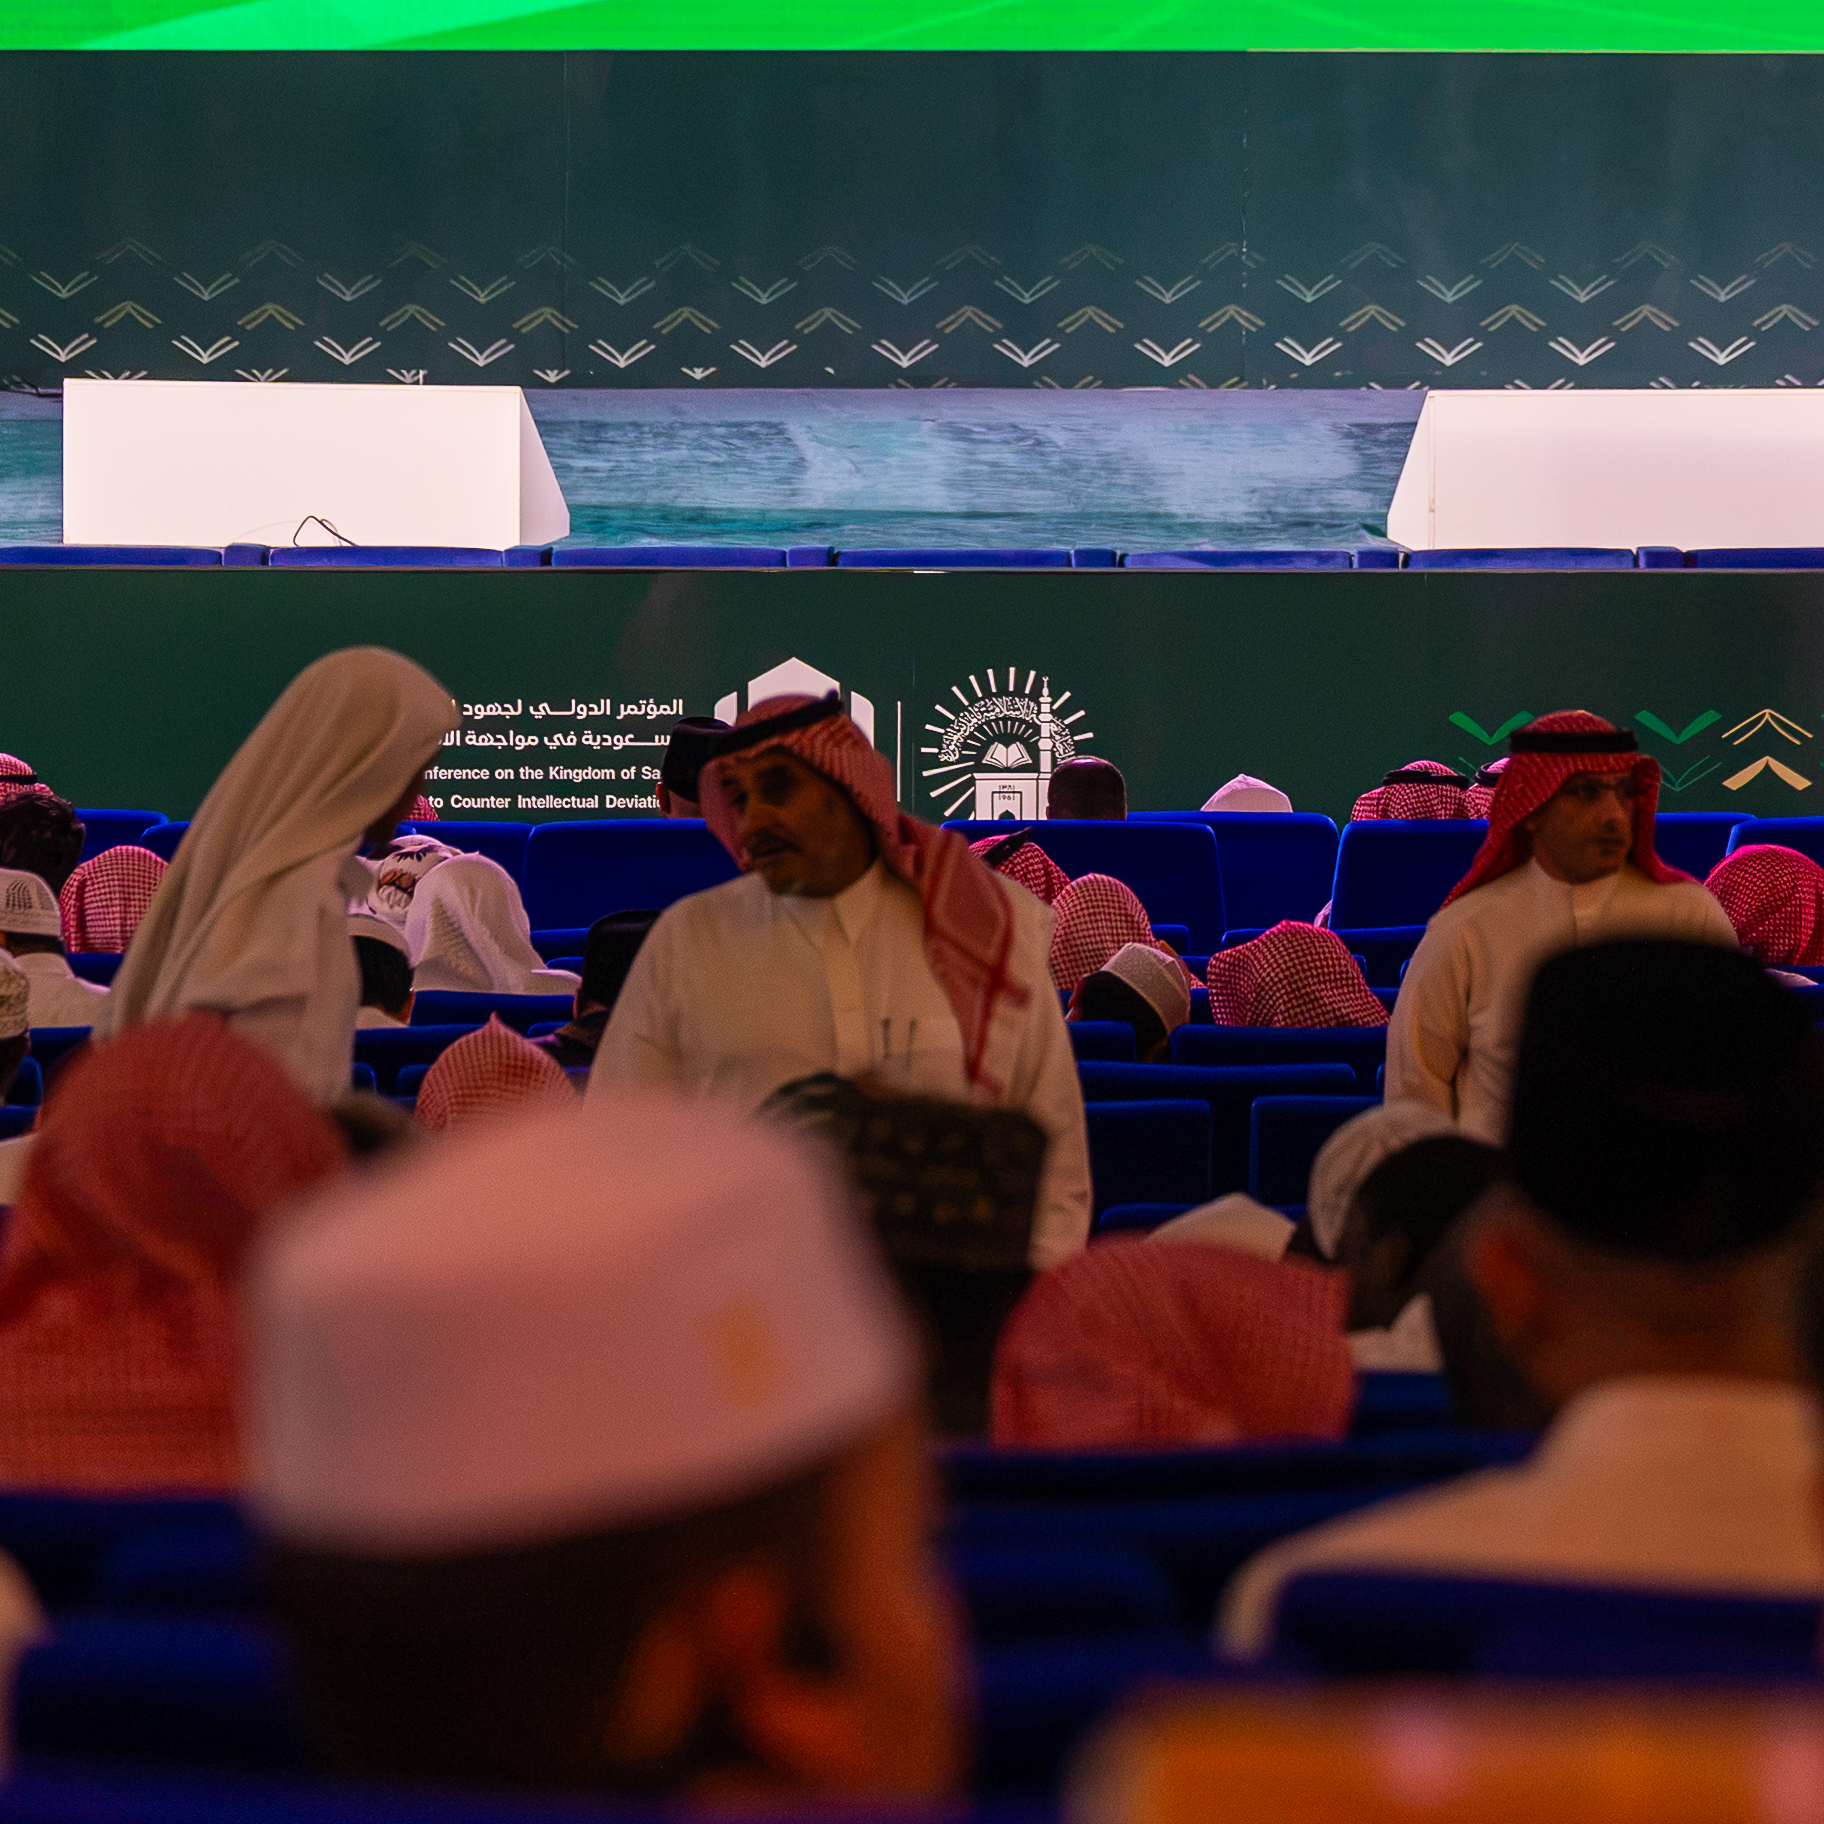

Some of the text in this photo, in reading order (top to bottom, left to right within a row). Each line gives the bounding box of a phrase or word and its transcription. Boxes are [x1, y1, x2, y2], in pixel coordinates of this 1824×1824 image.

[462, 698, 523, 720] لجهود
[528, 698, 611, 720] الدولي
[615, 697, 684, 720] المؤتمر
[464, 729, 540, 751] مواجهة
[543, 730, 578, 750] في
[581, 730, 671, 751] سعودية
[424, 765, 491, 780] nference
[494, 768, 515, 780] on
[518, 765, 544, 780] the
[548, 765, 616, 783] Kingdom
[620, 765, 637, 780] of
[450, 794, 512, 809] Counter
[517, 794, 599, 809] Intellectual
[605, 794, 661, 809] Deviati
